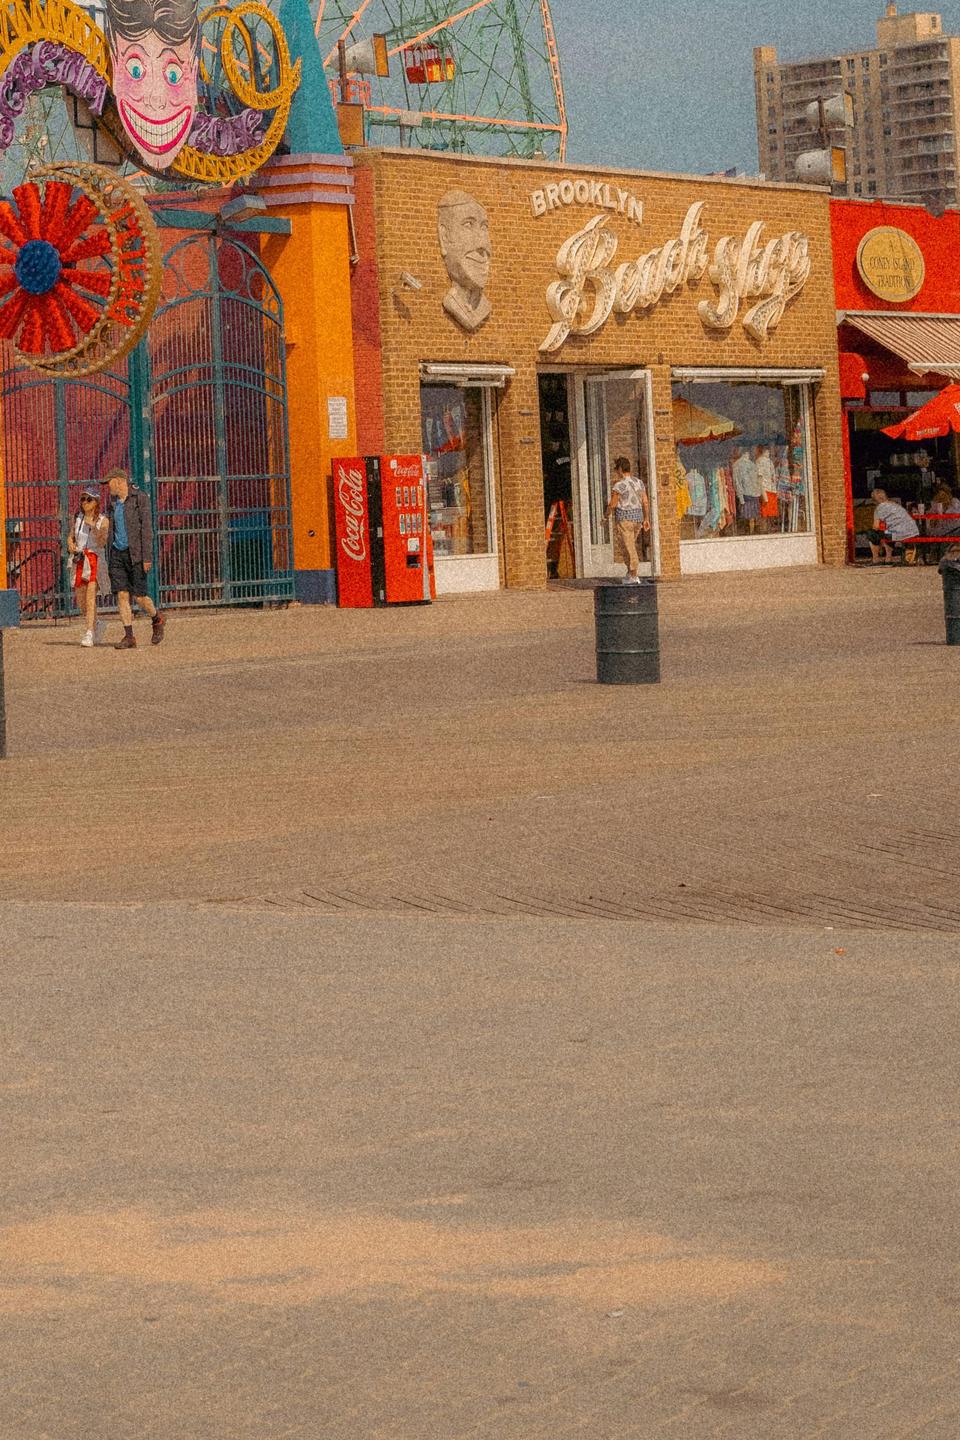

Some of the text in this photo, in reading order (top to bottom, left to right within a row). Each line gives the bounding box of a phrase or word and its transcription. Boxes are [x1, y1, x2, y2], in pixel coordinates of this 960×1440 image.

[529, 178, 644, 226] BROOKLYN
[538, 200, 811, 352] Beach Shop
[869, 256, 891, 270] CONEY
